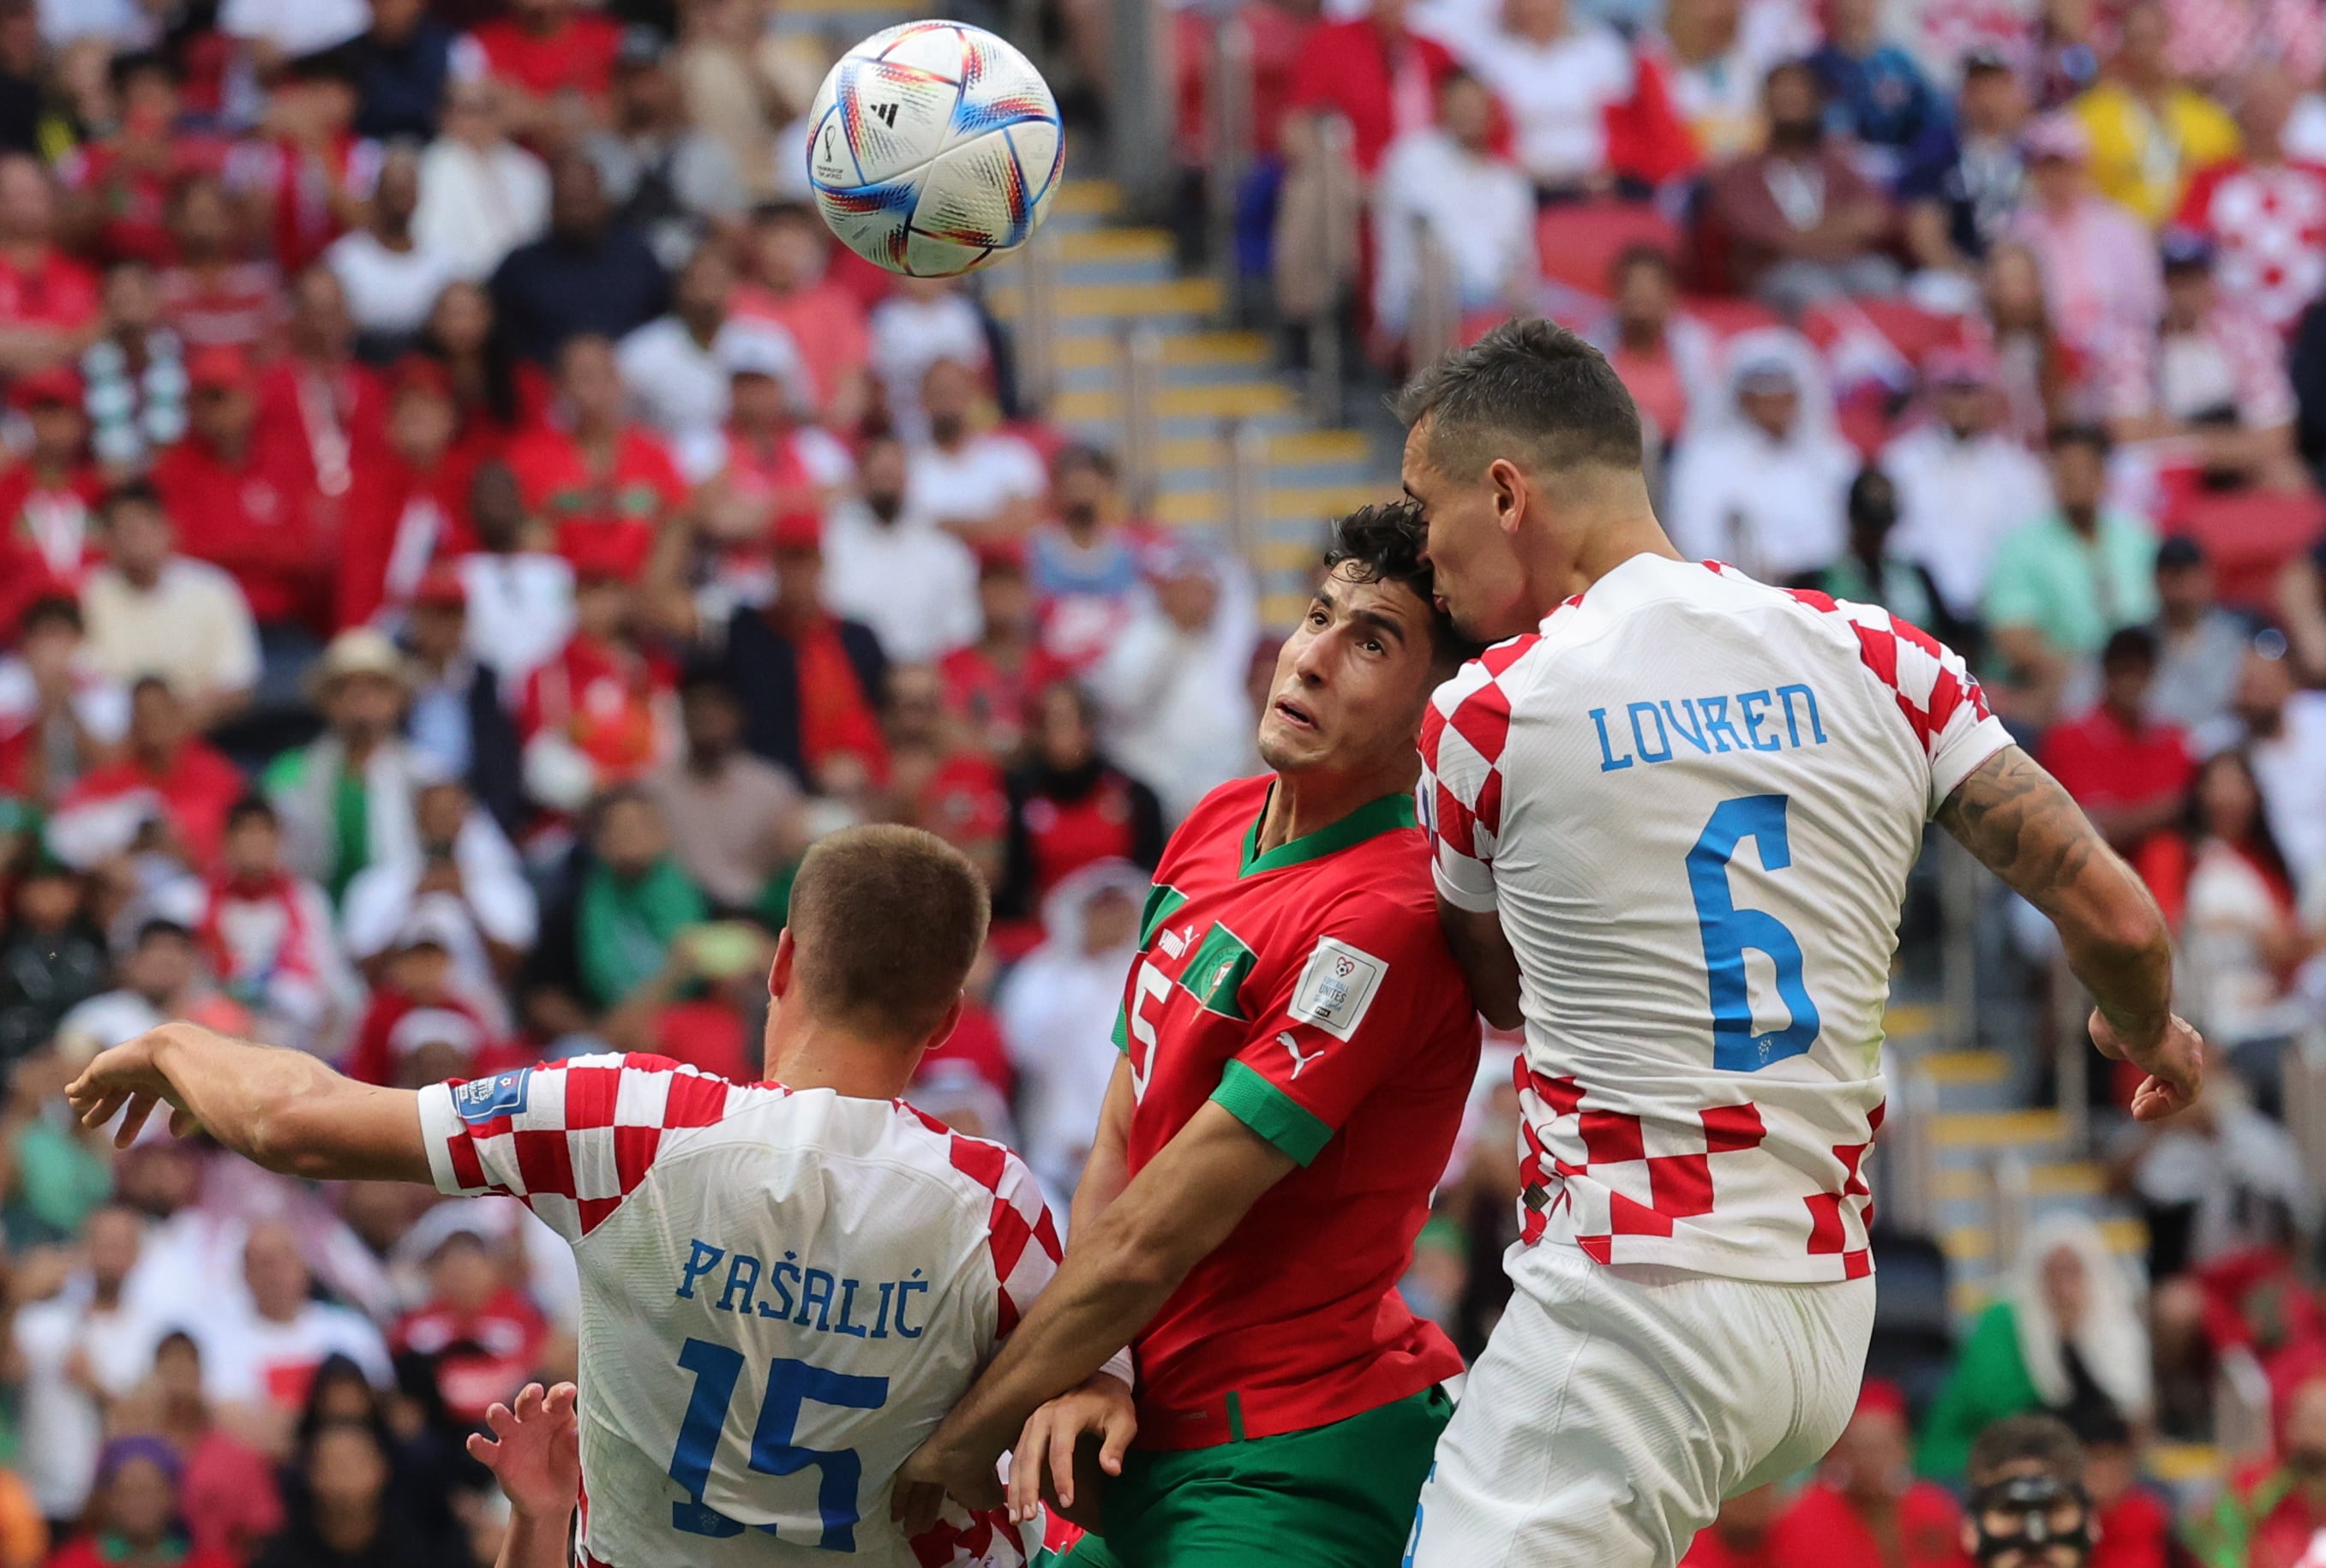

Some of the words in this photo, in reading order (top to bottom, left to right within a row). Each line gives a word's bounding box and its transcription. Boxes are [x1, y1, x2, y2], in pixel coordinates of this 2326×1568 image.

[1589, 683, 1828, 772] LOVREN
[1319, 984, 1347, 1003] UNITES
[1685, 794, 1820, 1073] 6
[1129, 959, 1173, 1107] 5
[675, 1238, 928, 1338] PAŠALIĆ
[668, 1337, 890, 1553] 15
